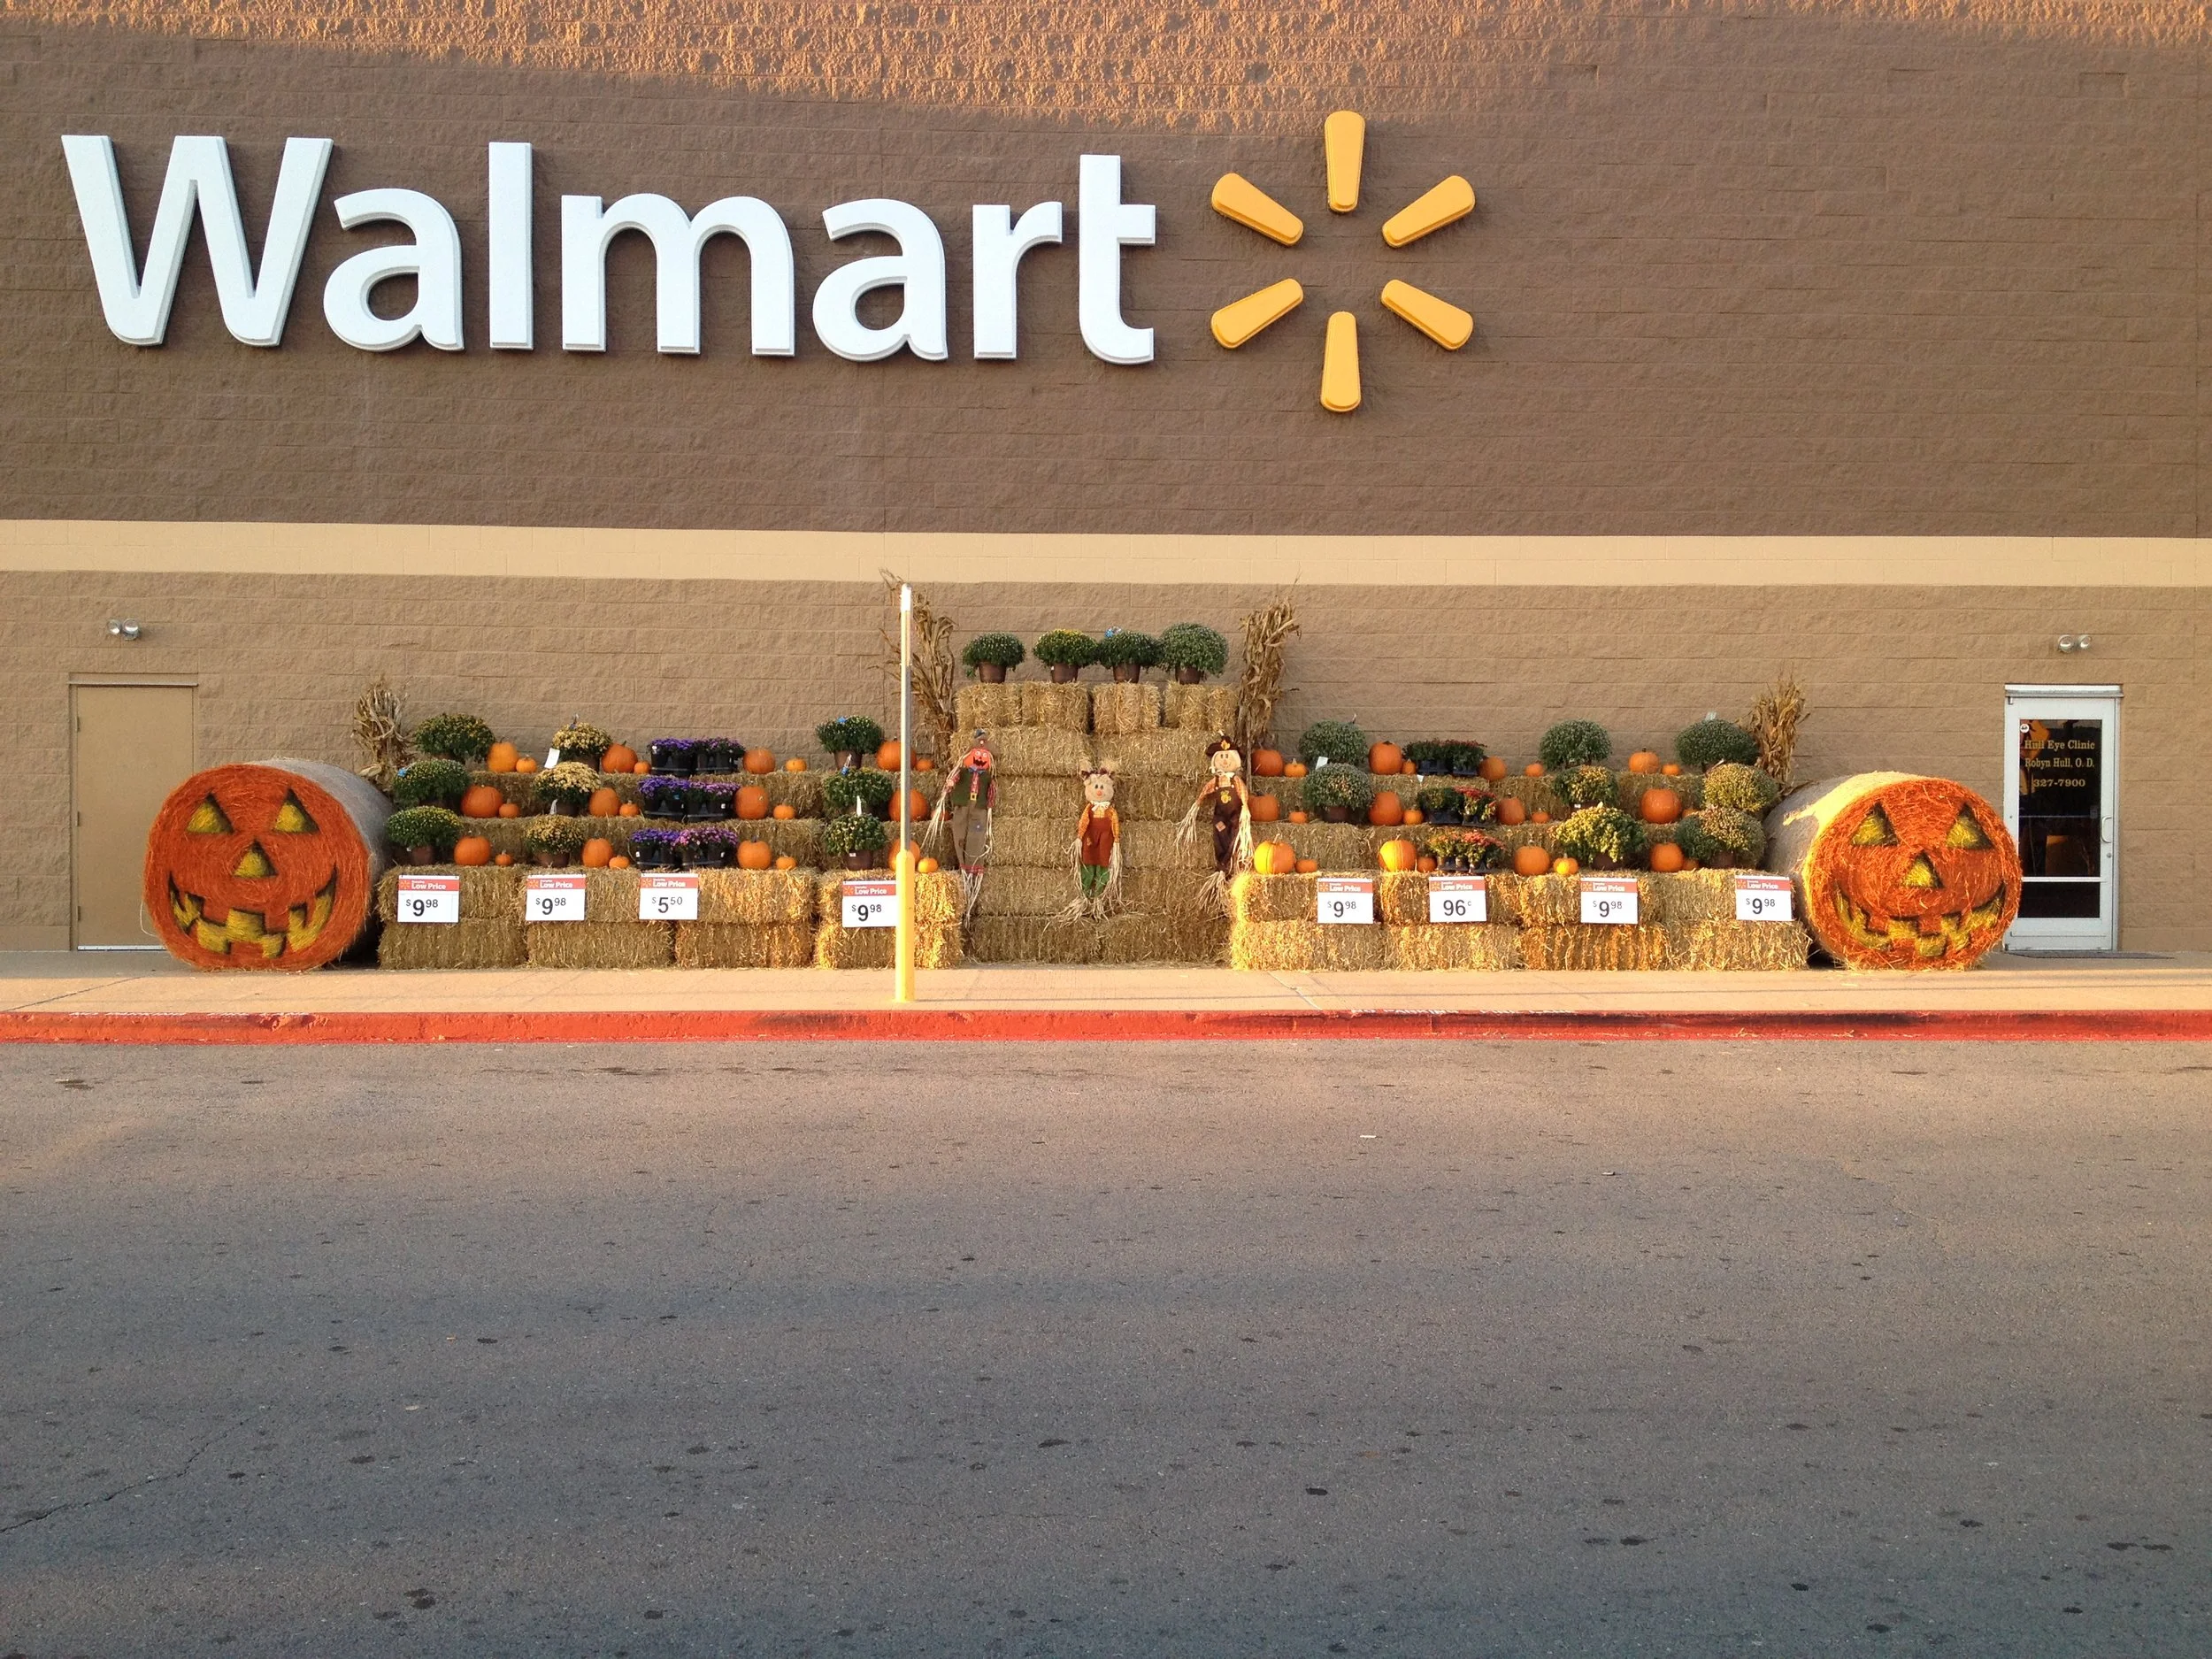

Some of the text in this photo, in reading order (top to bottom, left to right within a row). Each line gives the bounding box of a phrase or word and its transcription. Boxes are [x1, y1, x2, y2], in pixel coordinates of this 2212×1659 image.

[61, 134, 1156, 365] Walmart
[2024, 740, 2095, 751] Hull Eye Clinic
[2025, 757, 2051, 770] Robyn
